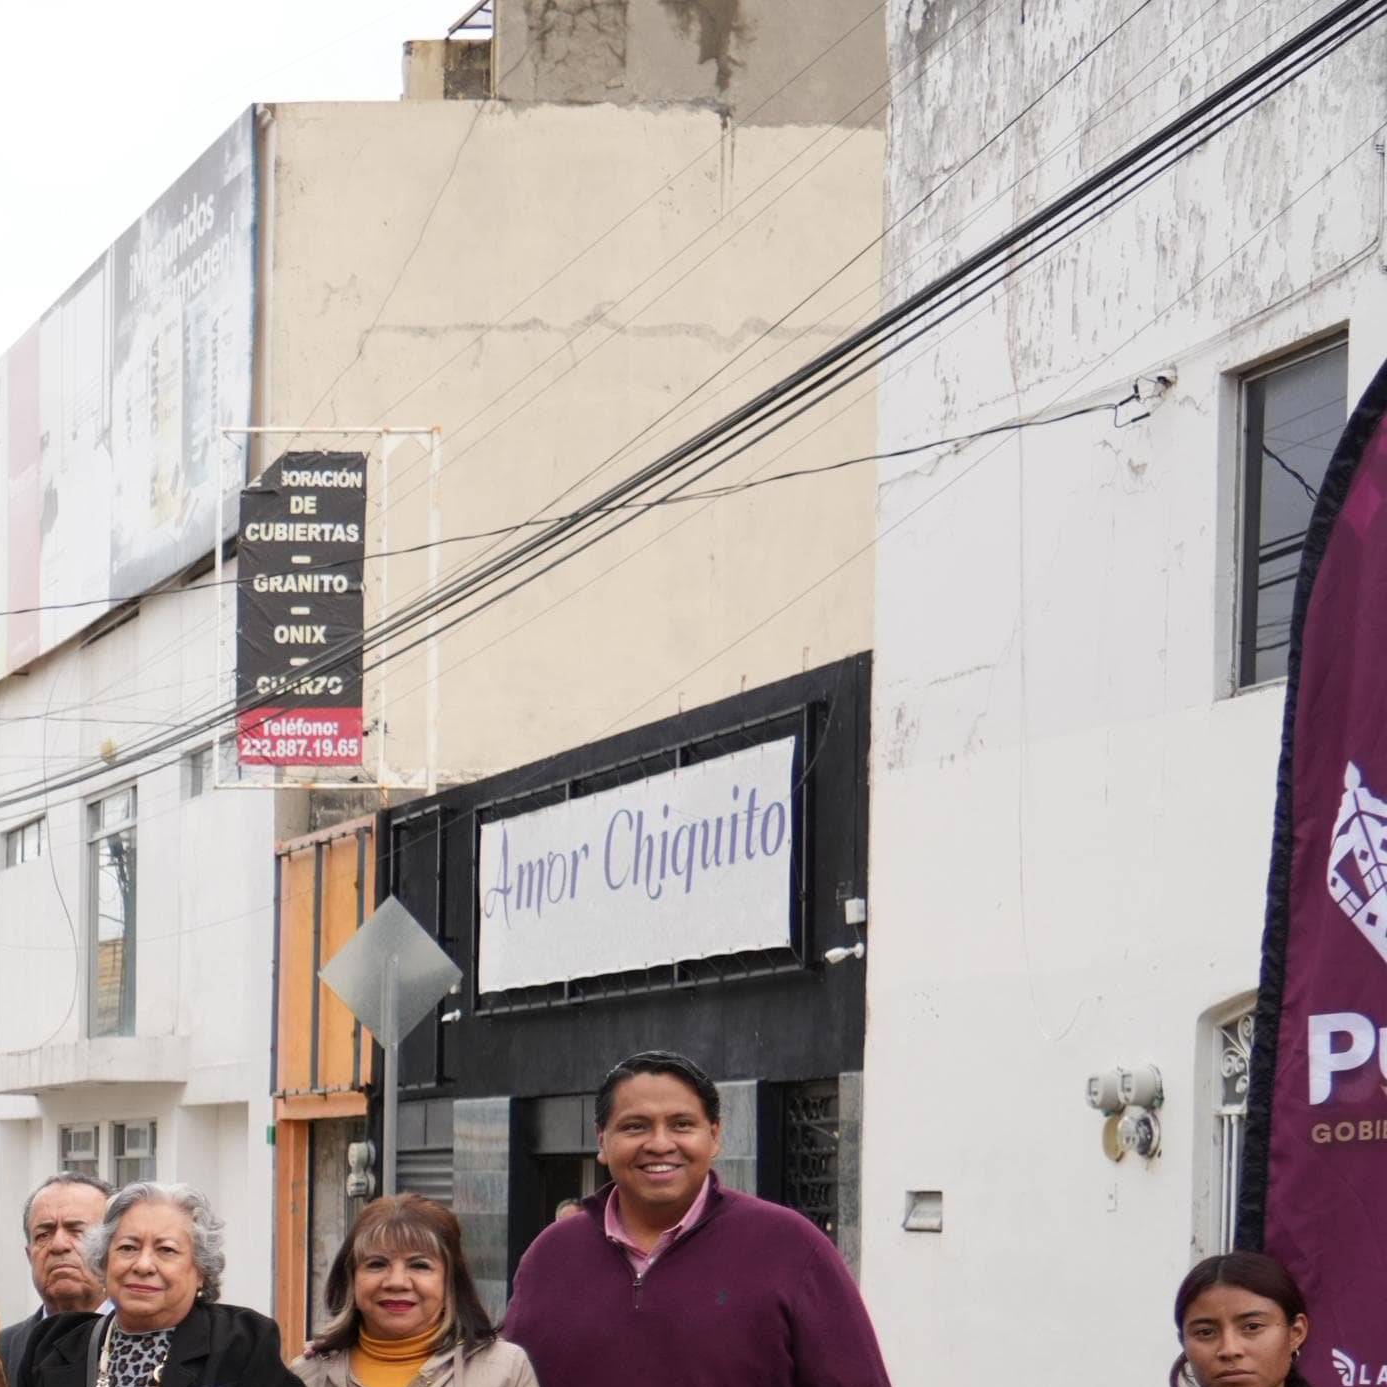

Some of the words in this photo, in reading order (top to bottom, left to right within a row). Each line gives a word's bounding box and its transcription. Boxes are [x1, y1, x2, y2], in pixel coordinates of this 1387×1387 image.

[289, 495, 317, 515] DE
[244, 522, 360, 543] CUBIERTAS
[253, 574, 348, 594] GRANITO
[274, 624, 326, 645] ONIX
[259, 716, 339, 737] Teléfono:
[241, 737, 360, 758] 222.887.19.65
[484, 826, 589, 930] Amor
[603, 784, 786, 900] Chiquito
